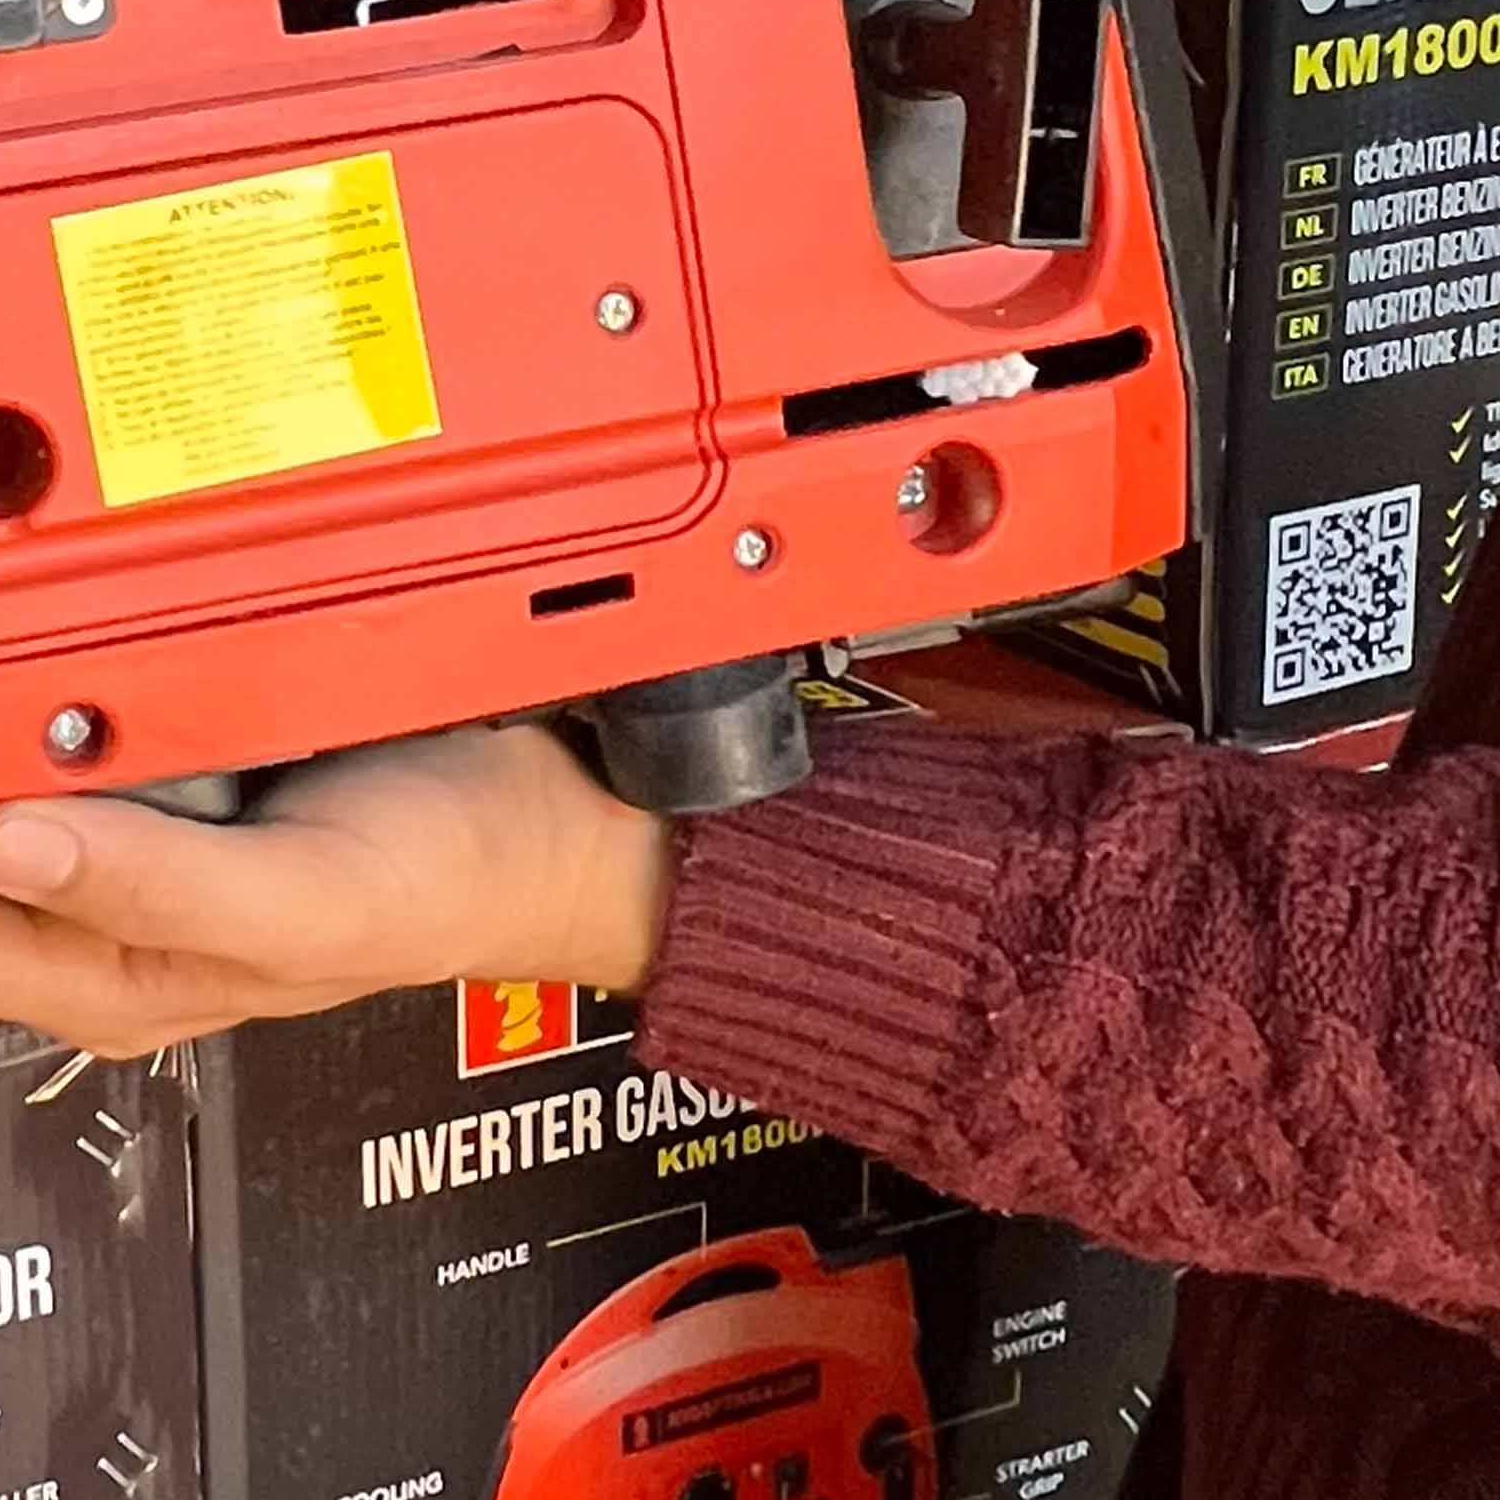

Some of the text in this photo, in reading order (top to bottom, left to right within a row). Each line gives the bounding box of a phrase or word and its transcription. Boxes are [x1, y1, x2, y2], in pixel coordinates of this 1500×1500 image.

[1299, 163, 1328, 189] FR
[1295, 214, 1324, 239] NL
[1351, 186, 1439, 237] INVERTER
[1290, 264, 1324, 289] DE
[1347, 235, 1434, 286] INVERTER
[1288, 314, 1321, 341] EN
[1344, 284, 1432, 335] INVERTER
[1283, 364, 1319, 390] ITA
[362, 1069, 758, 1209] INVERTER GASO
[657, 1117, 825, 1179] KM1800
[437, 1243, 531, 1287] HANDLE
[992, 1300, 1068, 1338] ENGINE
[991, 1327, 1067, 1363] SWITCH
[995, 1440, 1091, 1484] STRARTER
[338, 1471, 444, 1500] OLING
